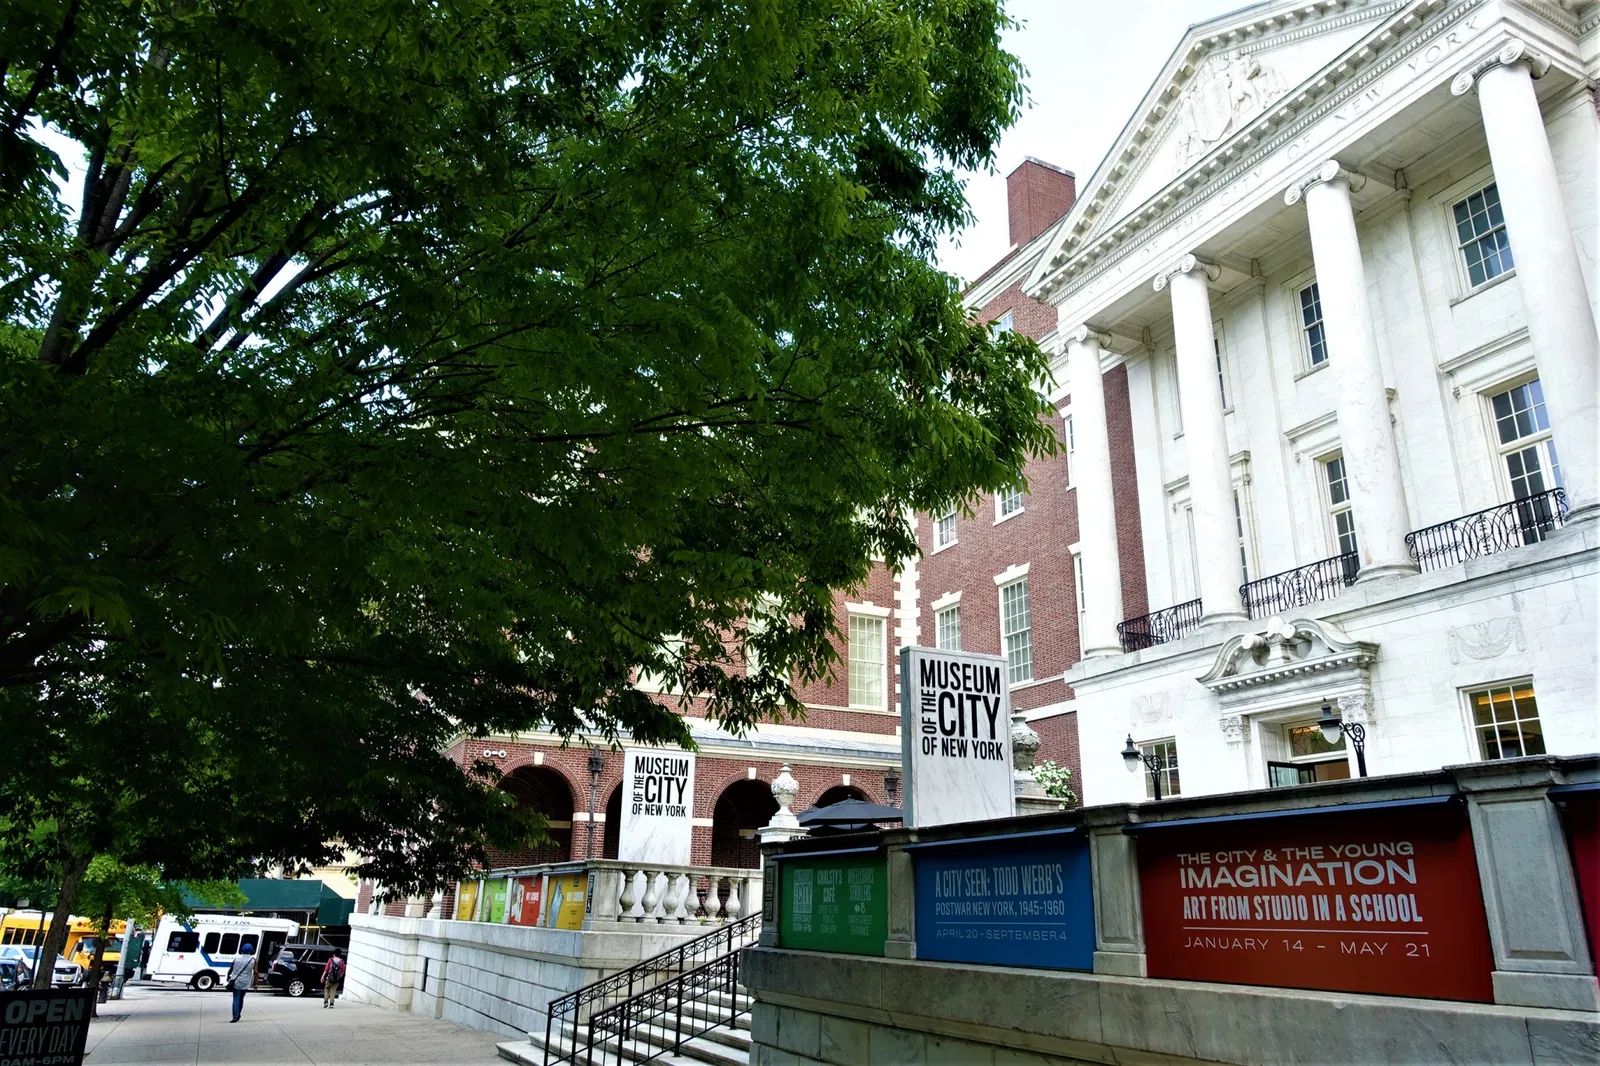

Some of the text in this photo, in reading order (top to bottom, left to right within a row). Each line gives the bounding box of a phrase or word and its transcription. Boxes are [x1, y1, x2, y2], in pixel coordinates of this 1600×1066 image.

[1173, 208, 1206, 240] THE
[1220, 166, 1263, 207] CITY
[1287, 133, 1311, 160] OF
[1333, 82, 1385, 121] NEW
[1407, 15, 1480, 73] YORK
[920, 658, 1000, 694] MUSEUM
[921, 689, 938, 734] OF THE
[938, 691, 1000, 740] CITY
[922, 736, 1004, 761] OF NEW YORK
[634, 756, 688, 777] MUSEUM
[633, 774, 644, 802] OF THE
[645, 776, 688, 804] CITY
[632, 803, 686, 817] OF NEW YORK
[1176, 841, 1414, 865] THE CITY & THE YOUNG
[936, 863, 1064, 898] A CITY SEEN: TODD WEBB'S
[1180, 859, 1417, 888] IMAGINATION
[936, 900, 1065, 917] POSTWAR NEW YORK, 1945-1960
[1184, 894, 1423, 922] ART FROM STUDIO IN A SCHOOL
[936, 929, 964, 939] APRIL
[966, 930, 978, 939] 20
[986, 930, 1058, 940] SEPTEMBER
[1060, 931, 1067, 940] 4
[1185, 937, 1269, 950] JANUARY
[1282, 940, 1304, 952] 14
[1340, 941, 1388, 955] MAY
[1405, 943, 1430, 957] 21
[5, 998, 85, 1024] OPEN
[0, 1025, 80, 1056] EVERY DAY
